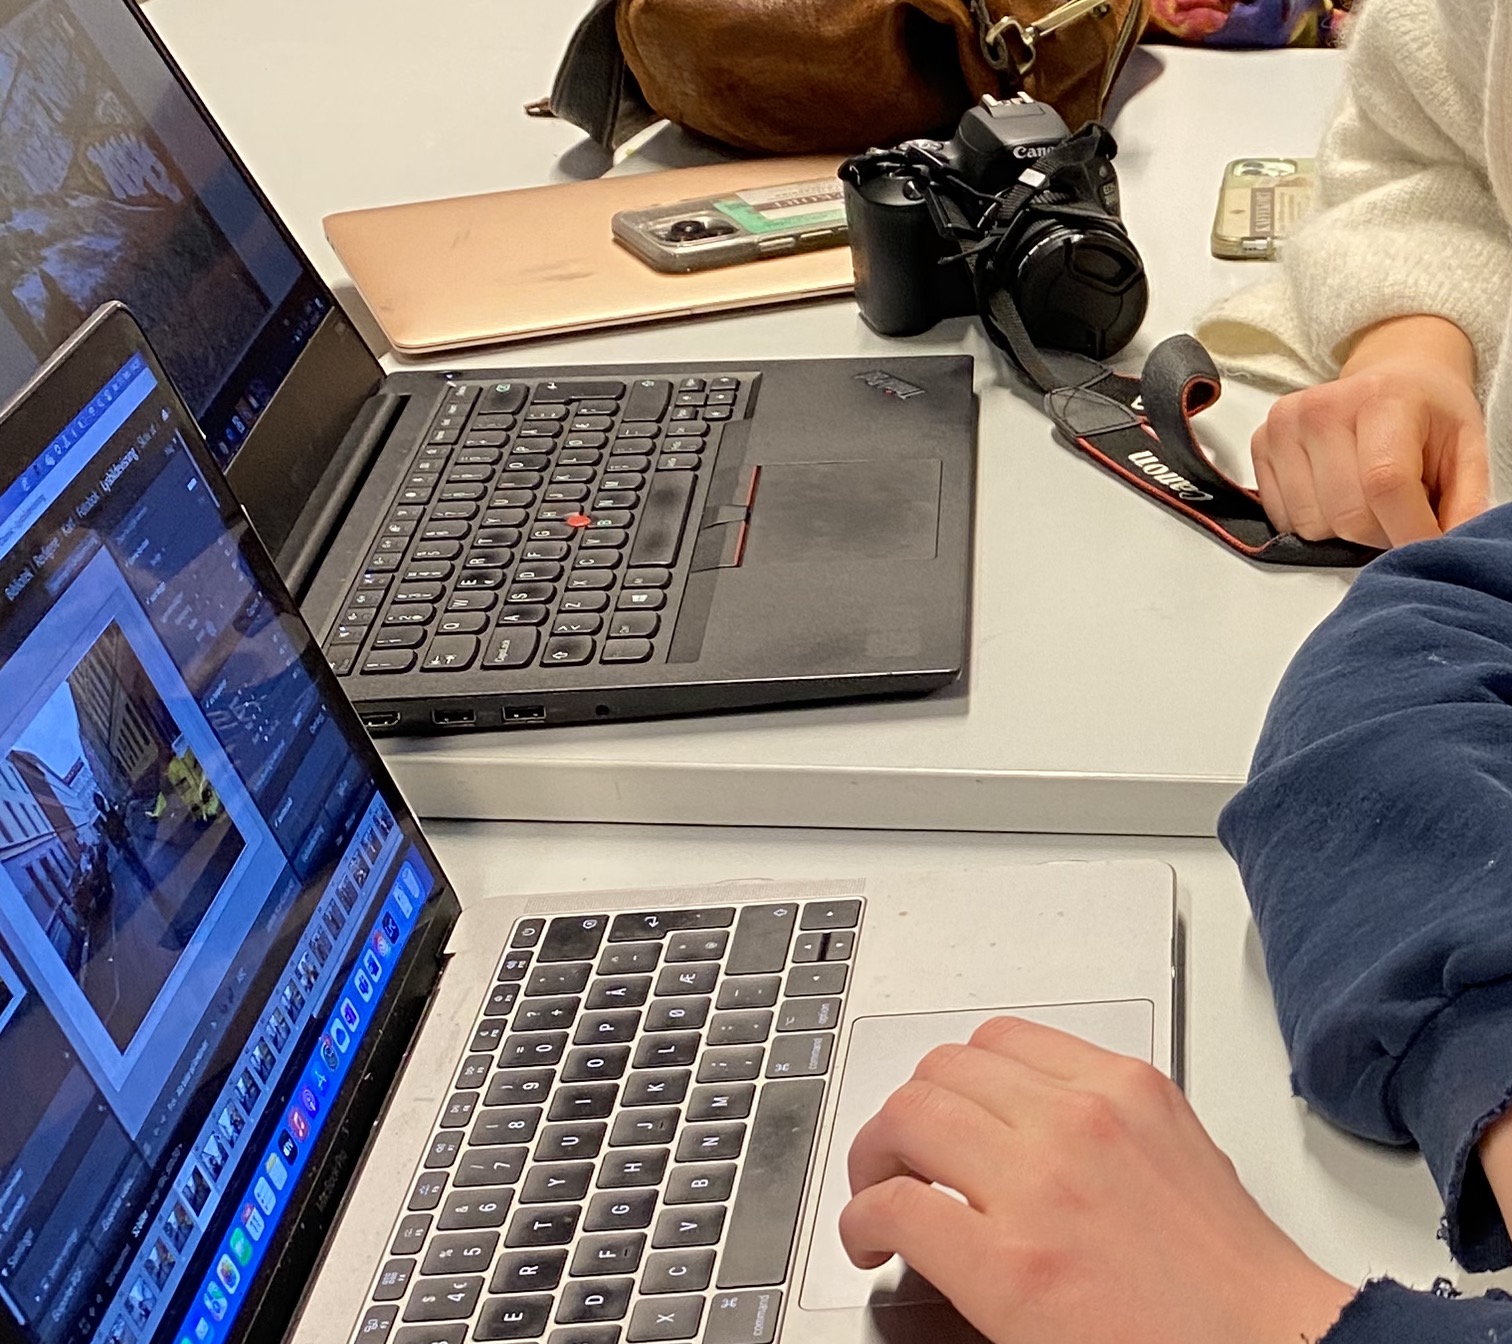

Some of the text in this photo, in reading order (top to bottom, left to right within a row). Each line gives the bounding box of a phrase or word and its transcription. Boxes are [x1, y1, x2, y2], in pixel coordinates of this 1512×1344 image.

[1128, 450, 1213, 500] Canon
[680, 973, 696, 984] Æ
[599, 1023, 615, 1031] P
[535, 1044, 553, 1053] 0
[657, 1045, 676, 1053] L
[586, 1059, 605, 1068] O
[522, 1082, 539, 1090] 9
[647, 1083, 665, 1092] K
[712, 1096, 729, 1107] M
[508, 1121, 526, 1130] 8
[637, 1122, 653, 1130] J
[561, 1136, 580, 1146] U
[702, 1136, 720, 1147] N
[493, 1162, 511, 1170] 7
[624, 1162, 643, 1172] H
[548, 1178, 565, 1187] Y
[691, 1179, 709, 1188] B
[479, 1203, 497, 1212] 6
[611, 1204, 630, 1214] G
[533, 1221, 552, 1230] T
[679, 1222, 698, 1231] V
[463, 1247, 482, 1256] 5
[598, 1250, 617, 1258] F
[518, 1265, 539, 1275] R
[668, 1266, 687, 1276] C
[447, 1293, 466, 1302] 4
[585, 1295, 604, 1305] D
[503, 1312, 523, 1321] E
[656, 1313, 676, 1323] X
[753, 1294, 770, 1337] command
